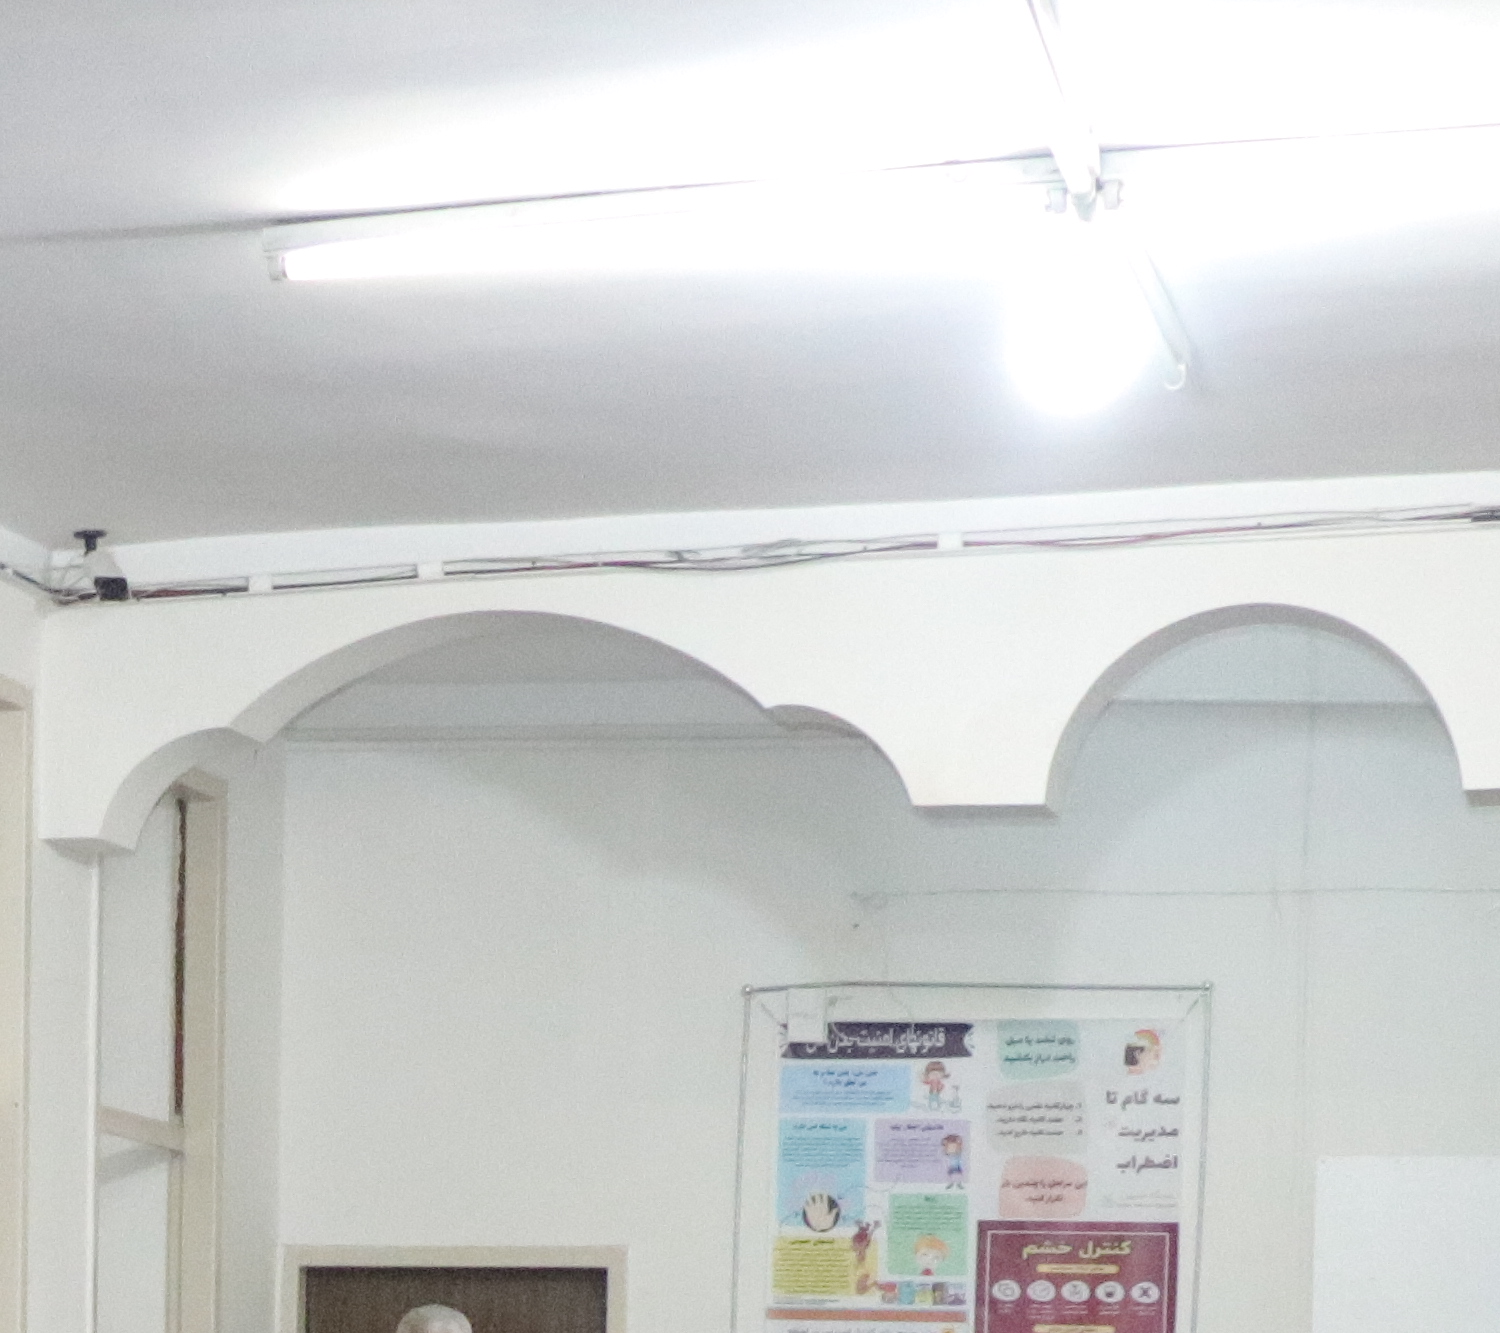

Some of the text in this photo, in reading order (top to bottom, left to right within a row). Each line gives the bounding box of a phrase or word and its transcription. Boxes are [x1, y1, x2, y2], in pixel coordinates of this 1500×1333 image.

[1105, 1089, 1180, 1111] سه گام تا
[1118, 1125, 1179, 1143] مدیریت
[1117, 1154, 1178, 1174] اضطراب
[1022, 1240, 1132, 1260] کنترل خشم
